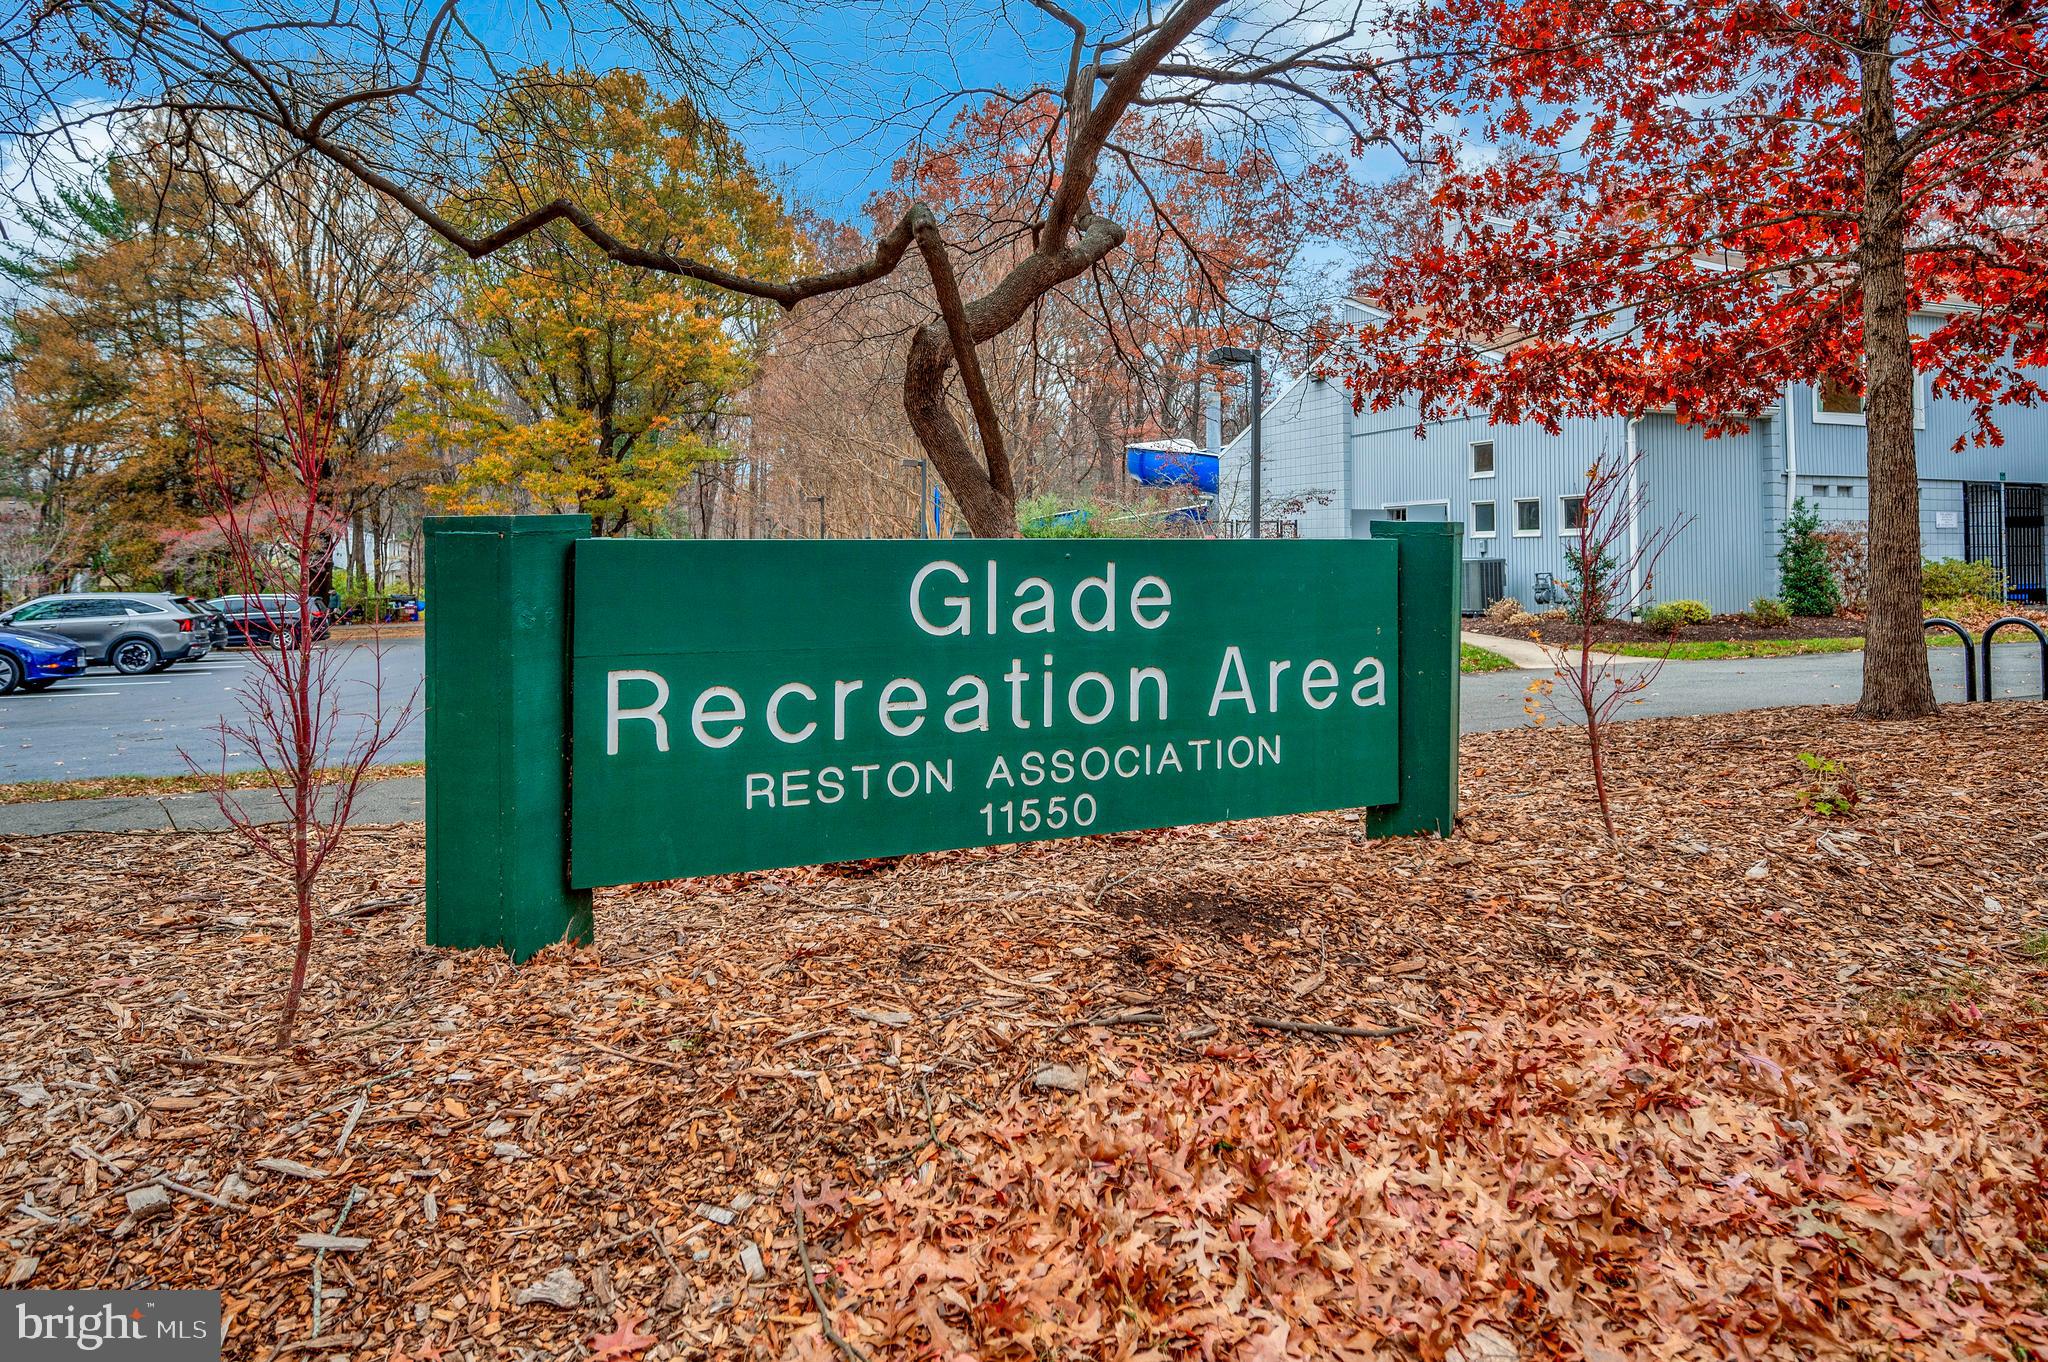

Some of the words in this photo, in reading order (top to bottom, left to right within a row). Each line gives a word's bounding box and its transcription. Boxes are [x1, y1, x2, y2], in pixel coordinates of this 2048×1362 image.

[909, 559, 1172, 637] Glade
[606, 654, 1168, 756] Recreation
[1208, 646, 1386, 717] Area
[746, 763, 953, 810] RESTON
[985, 734, 1281, 789] ASSOCIATION
[979, 793, 1097, 836] 11550
